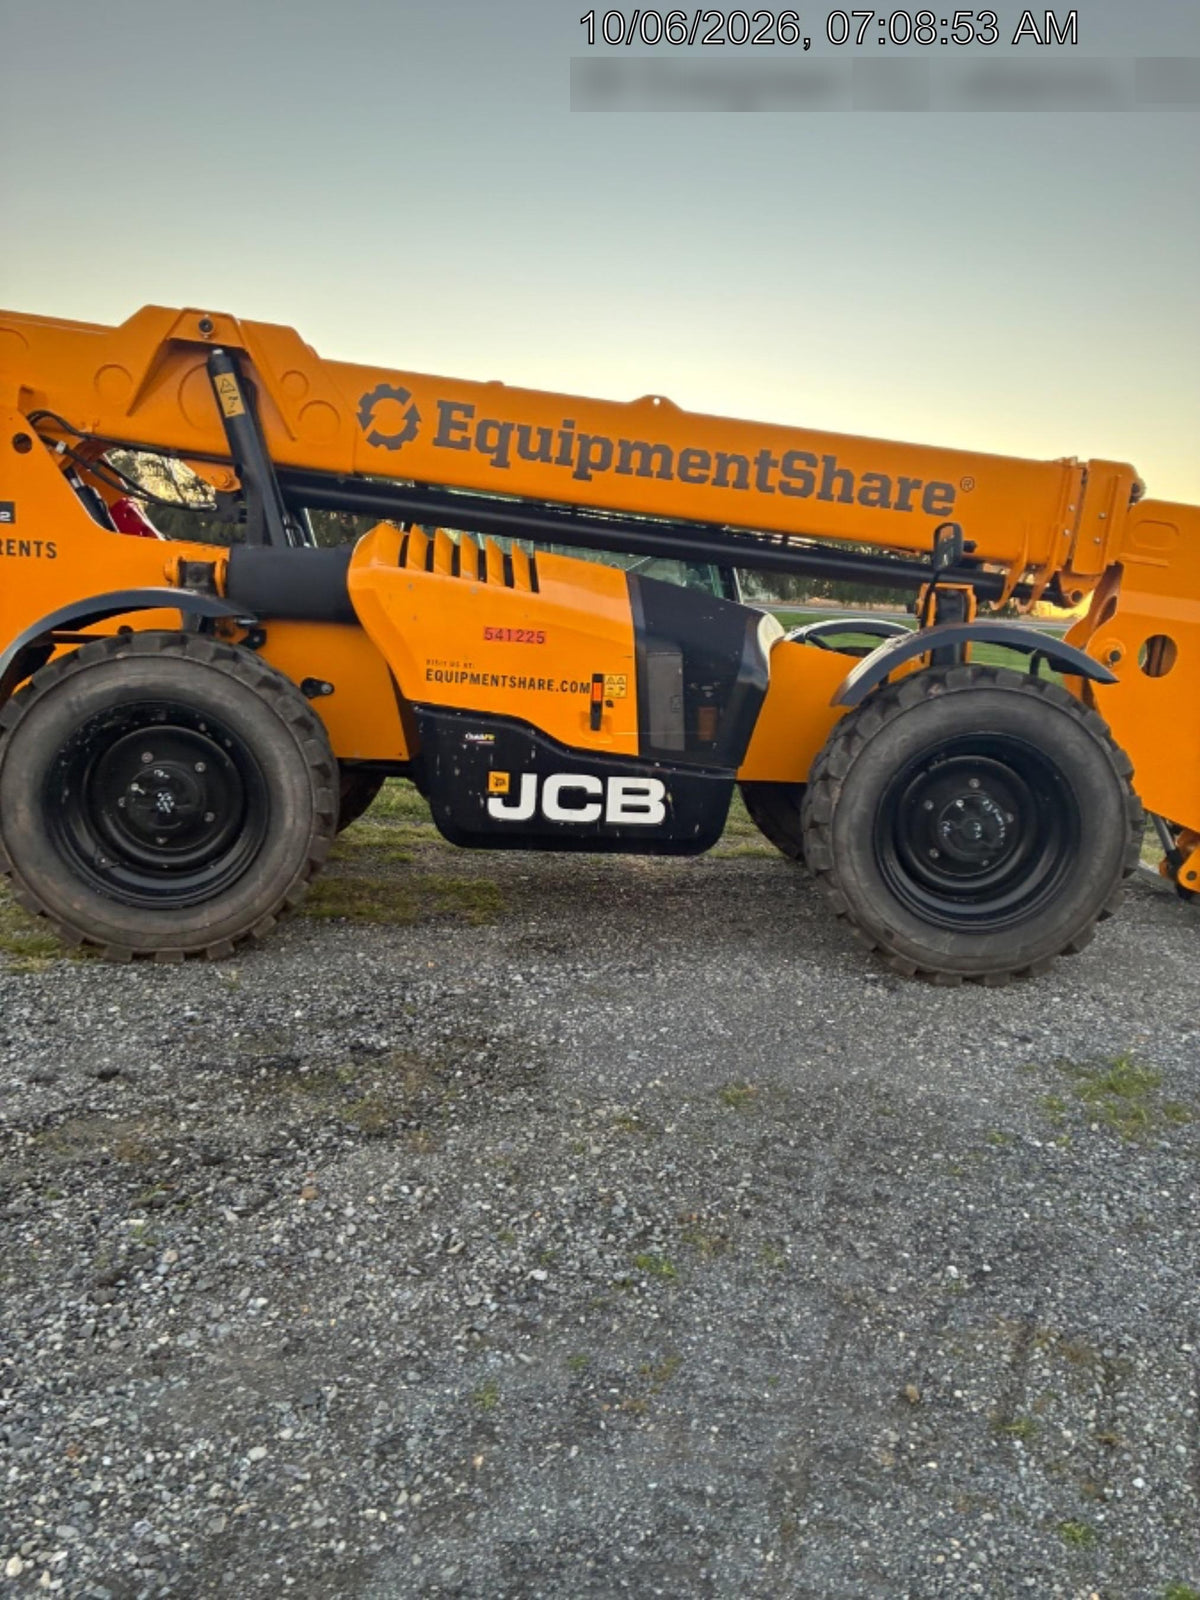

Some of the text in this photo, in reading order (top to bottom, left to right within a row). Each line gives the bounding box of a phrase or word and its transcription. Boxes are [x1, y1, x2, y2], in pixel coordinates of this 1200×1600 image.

[484, 627, 545, 644] 541225
[426, 668, 591, 694] EQUIPMENTSHARE.COM
[487, 772, 666, 825] JCB
